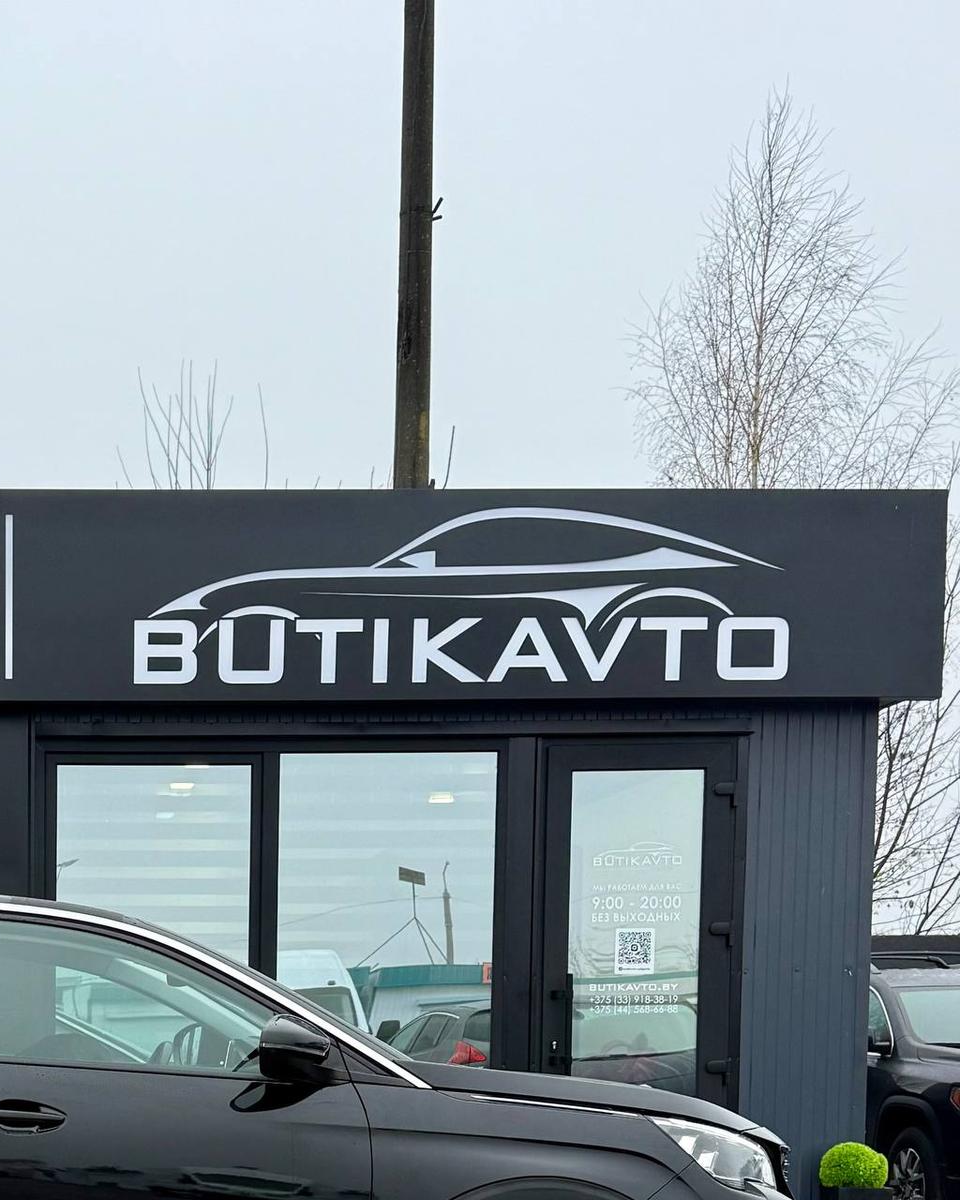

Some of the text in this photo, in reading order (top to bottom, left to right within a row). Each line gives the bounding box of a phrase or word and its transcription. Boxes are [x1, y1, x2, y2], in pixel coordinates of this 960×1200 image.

[133, 616, 790, 685] BUTIKAVTO
[593, 856, 682, 866] BUTIKAVTO
[592, 896, 624, 909] 9:00
[640, 895, 681, 909] 20:00
[592, 911, 681, 922] БЕЗ ВЫХОДНЫХ
[589, 983, 679, 992] BUTIKAVTO.BY
[589, 995, 679, 1006] +375 (33) 918-38-19
[589, 1005, 611, 1014] +375
